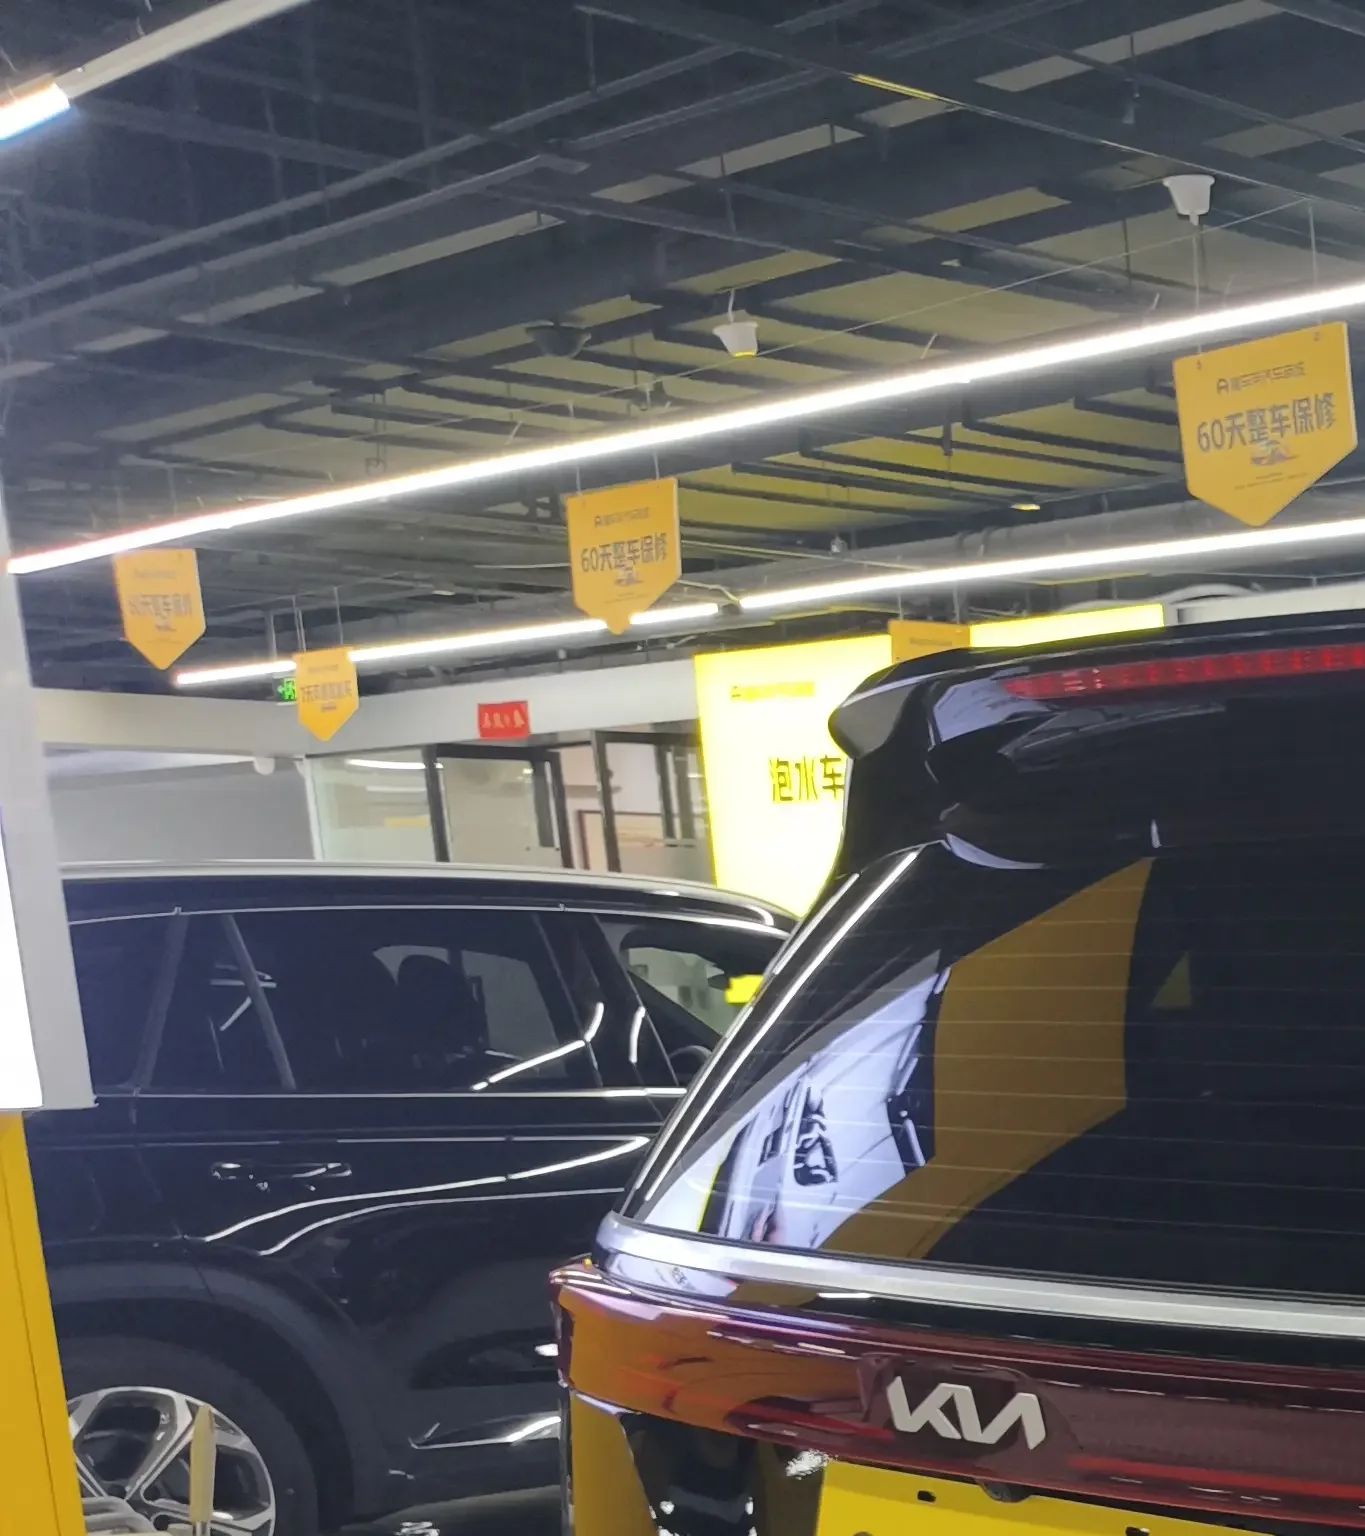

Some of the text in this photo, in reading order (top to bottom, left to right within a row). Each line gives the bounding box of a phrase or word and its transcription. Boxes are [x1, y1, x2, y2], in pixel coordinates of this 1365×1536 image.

[1196, 392, 1337, 453] 60天整车保修
[886, 1376, 1046, 1450] KIA
